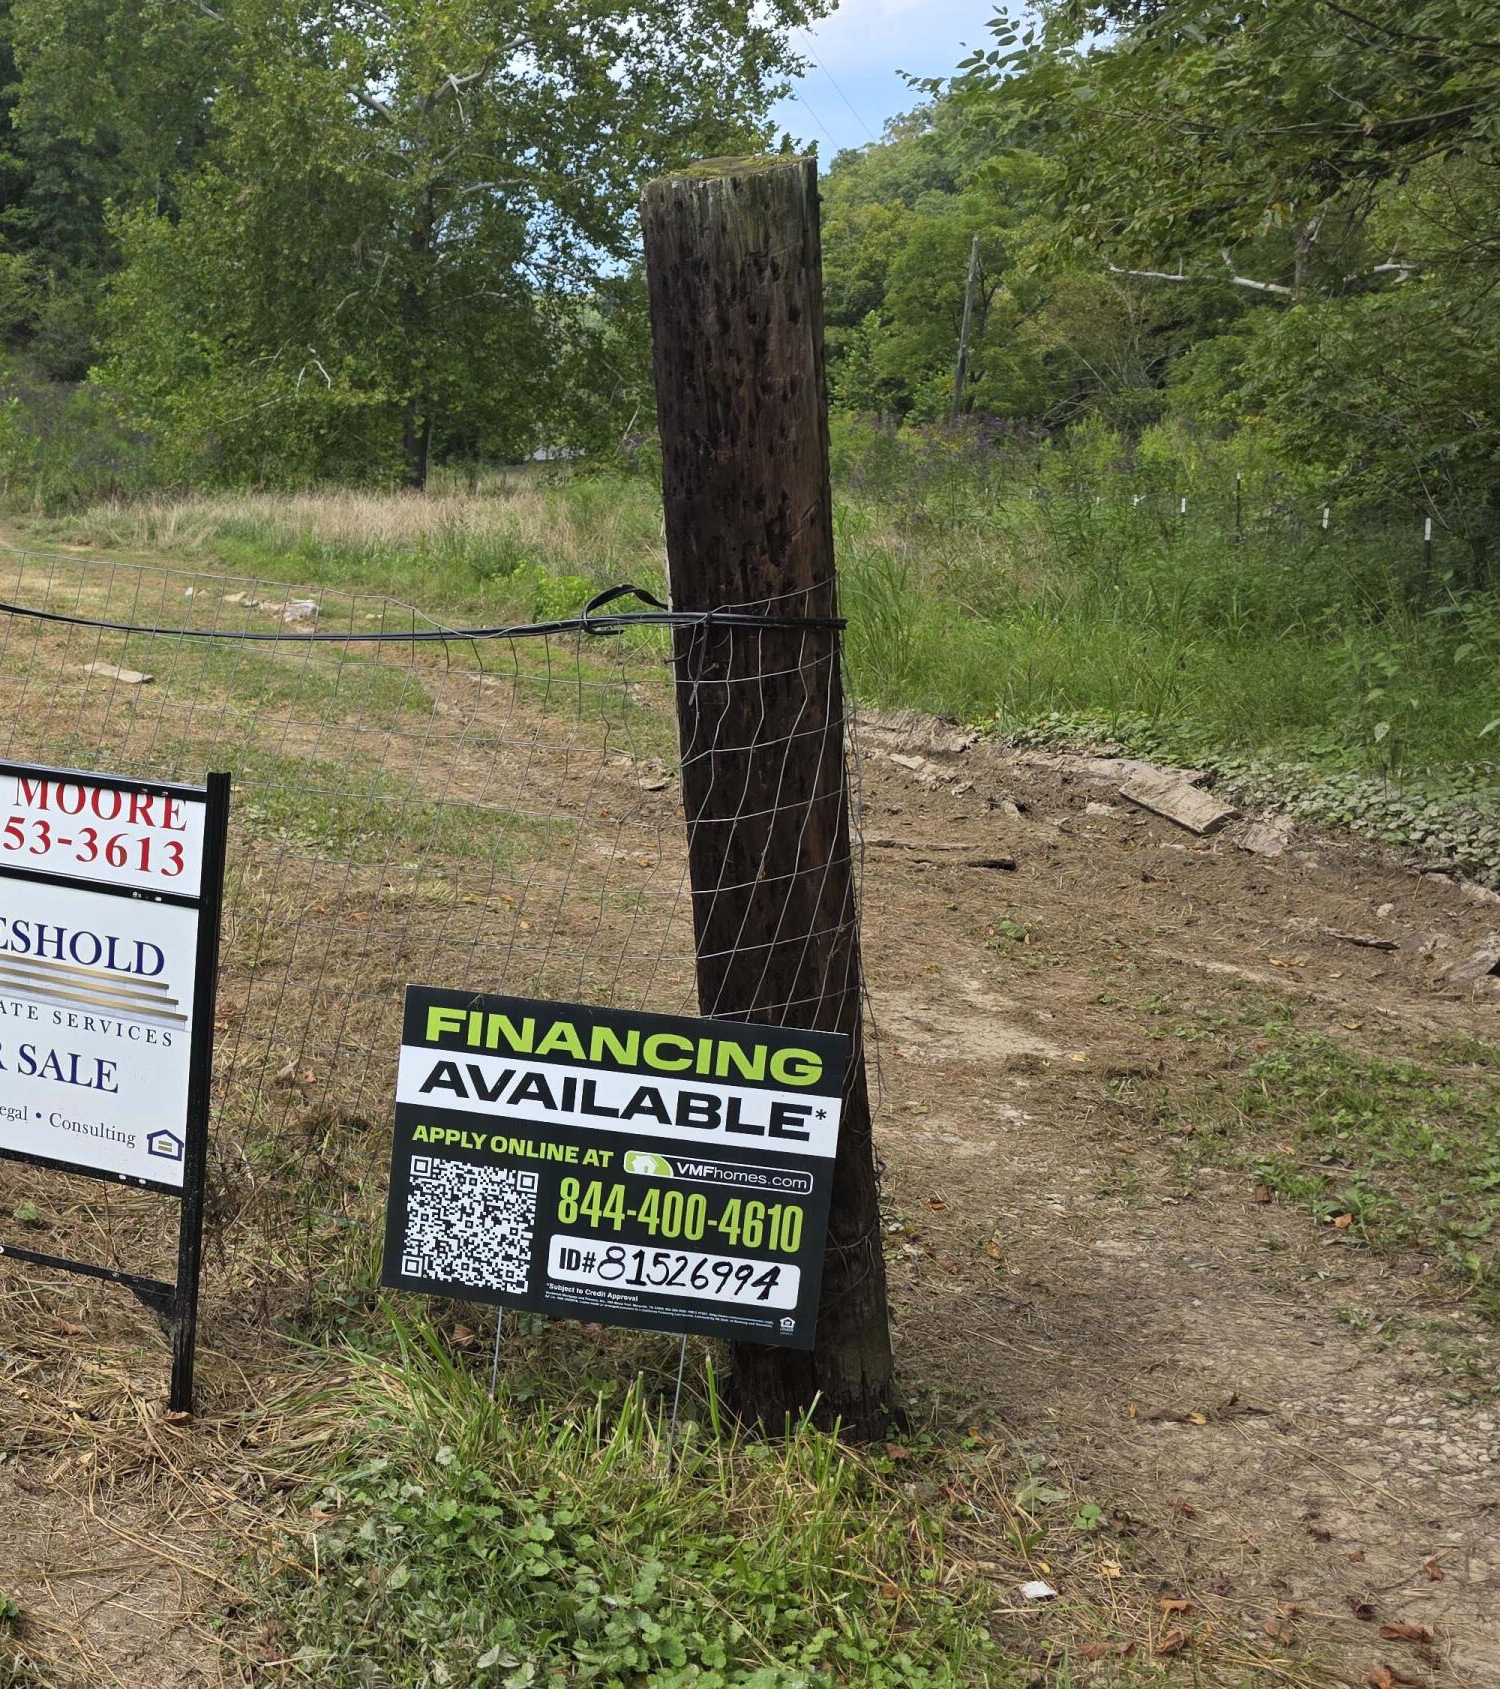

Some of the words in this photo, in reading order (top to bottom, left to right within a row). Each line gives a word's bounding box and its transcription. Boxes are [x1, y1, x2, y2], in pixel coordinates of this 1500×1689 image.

[13, 776, 187, 831] MOORE
[52, 1010, 173, 1047] SERVICES
[425, 1006, 823, 1086] FINANCING
[18, 1043, 119, 1094] SALE
[49, 1112, 136, 1149] Consulting
[412, 1124, 488, 1150] APPLY
[490, 1135, 579, 1164] ONLINE
[583, 1149, 614, 1168] AT
[676, 1161, 809, 1194] VMFhomes.com
[558, 1176, 805, 1254] 844-400-4610
[576, 1287, 583, 1295] to
[584, 1288, 606, 1298] Credit
[607, 1292, 638, 1302] Approval
